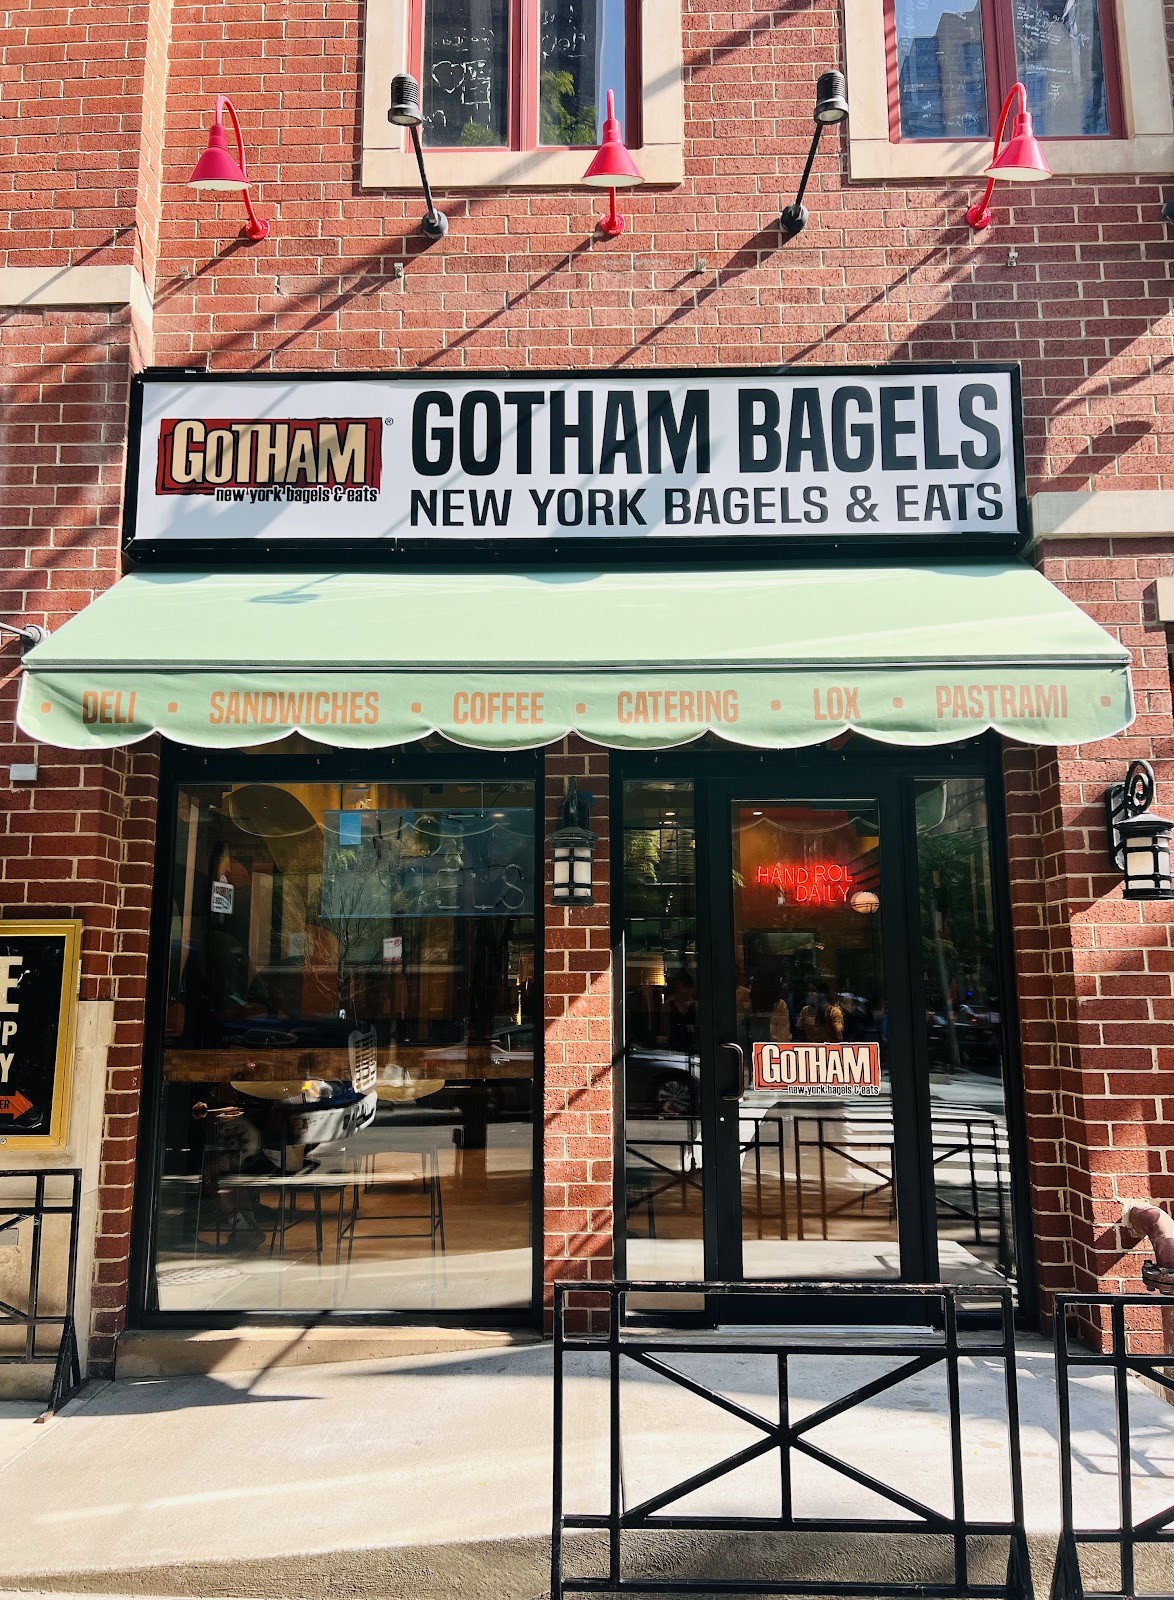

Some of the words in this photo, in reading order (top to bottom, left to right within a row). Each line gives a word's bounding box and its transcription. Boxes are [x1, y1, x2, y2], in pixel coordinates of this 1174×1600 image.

[411, 389, 709, 477] GOTHAM
[738, 383, 1001, 473] BAGELS
[169, 419, 366, 484] GOTHAM
[216, 488, 246, 502] new
[249, 486, 283, 504] york
[286, 486, 330, 504] bagels
[347, 487, 378, 502] eats
[410, 489, 511, 527] NEW
[529, 488, 647, 527] YORK
[664, 486, 829, 525] BAGELS
[846, 485, 878, 522] &
[896, 482, 1003, 522] EATS
[82, 691, 137, 724] DELI
[209, 691, 380, 725] SANDWICHES
[452, 691, 544, 725] COFFEE
[617, 689, 739, 724] CATERING
[813, 687, 861, 721] LOX
[935, 684, 1068, 719] PASTRAMI
[757, 865, 809, 884] HAND
[796, 884, 850, 903] DAILY
[762, 1044, 871, 1083] GOTHAM
[788, 1085, 805, 1094] new
[807, 1085, 826, 1095] york
[861, 1085, 879, 1095] eats
